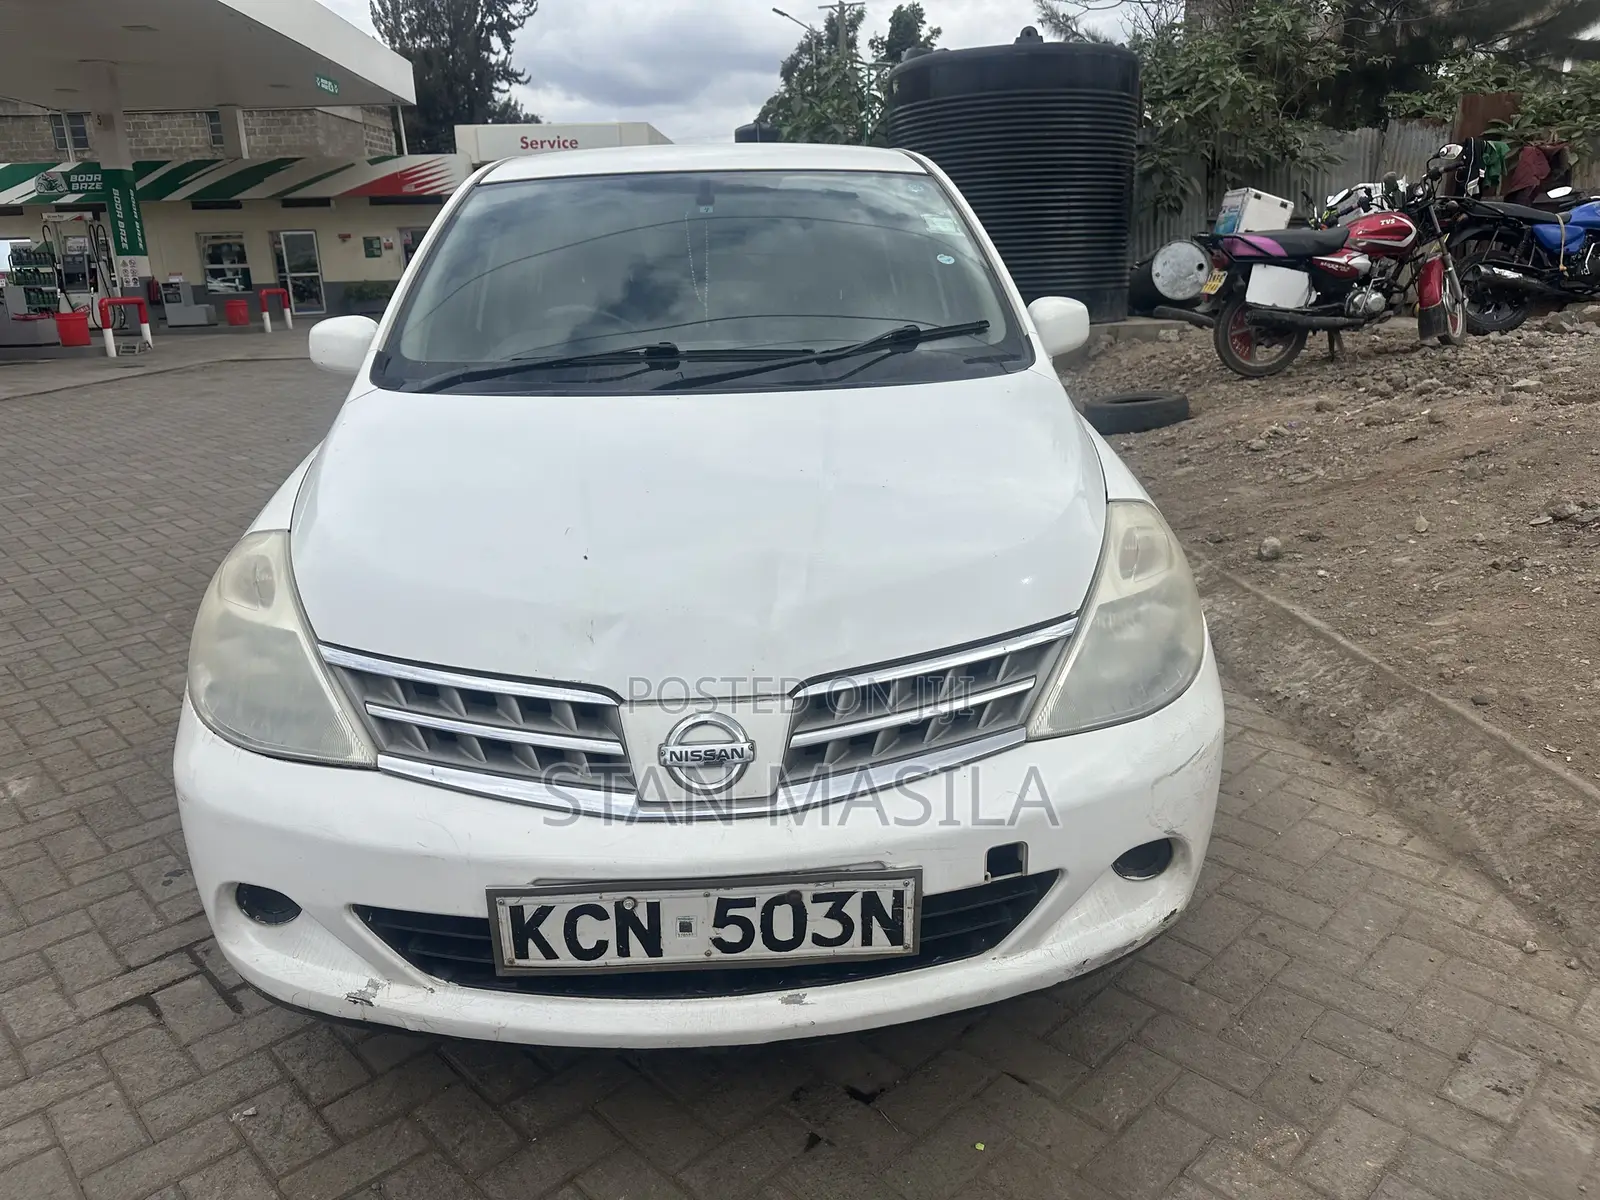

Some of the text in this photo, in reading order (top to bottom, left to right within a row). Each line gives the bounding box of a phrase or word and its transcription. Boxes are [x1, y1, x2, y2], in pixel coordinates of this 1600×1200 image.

[520, 135, 579, 150] Service
[70, 173, 102, 182] BODA
[71, 182, 103, 191] BAZE
[112, 187, 129, 250] BODA BAZE
[1380, 218, 1396, 226] TVS
[669, 747, 745, 763] NISSAN
[508, 889, 905, 962] KCN 503N
